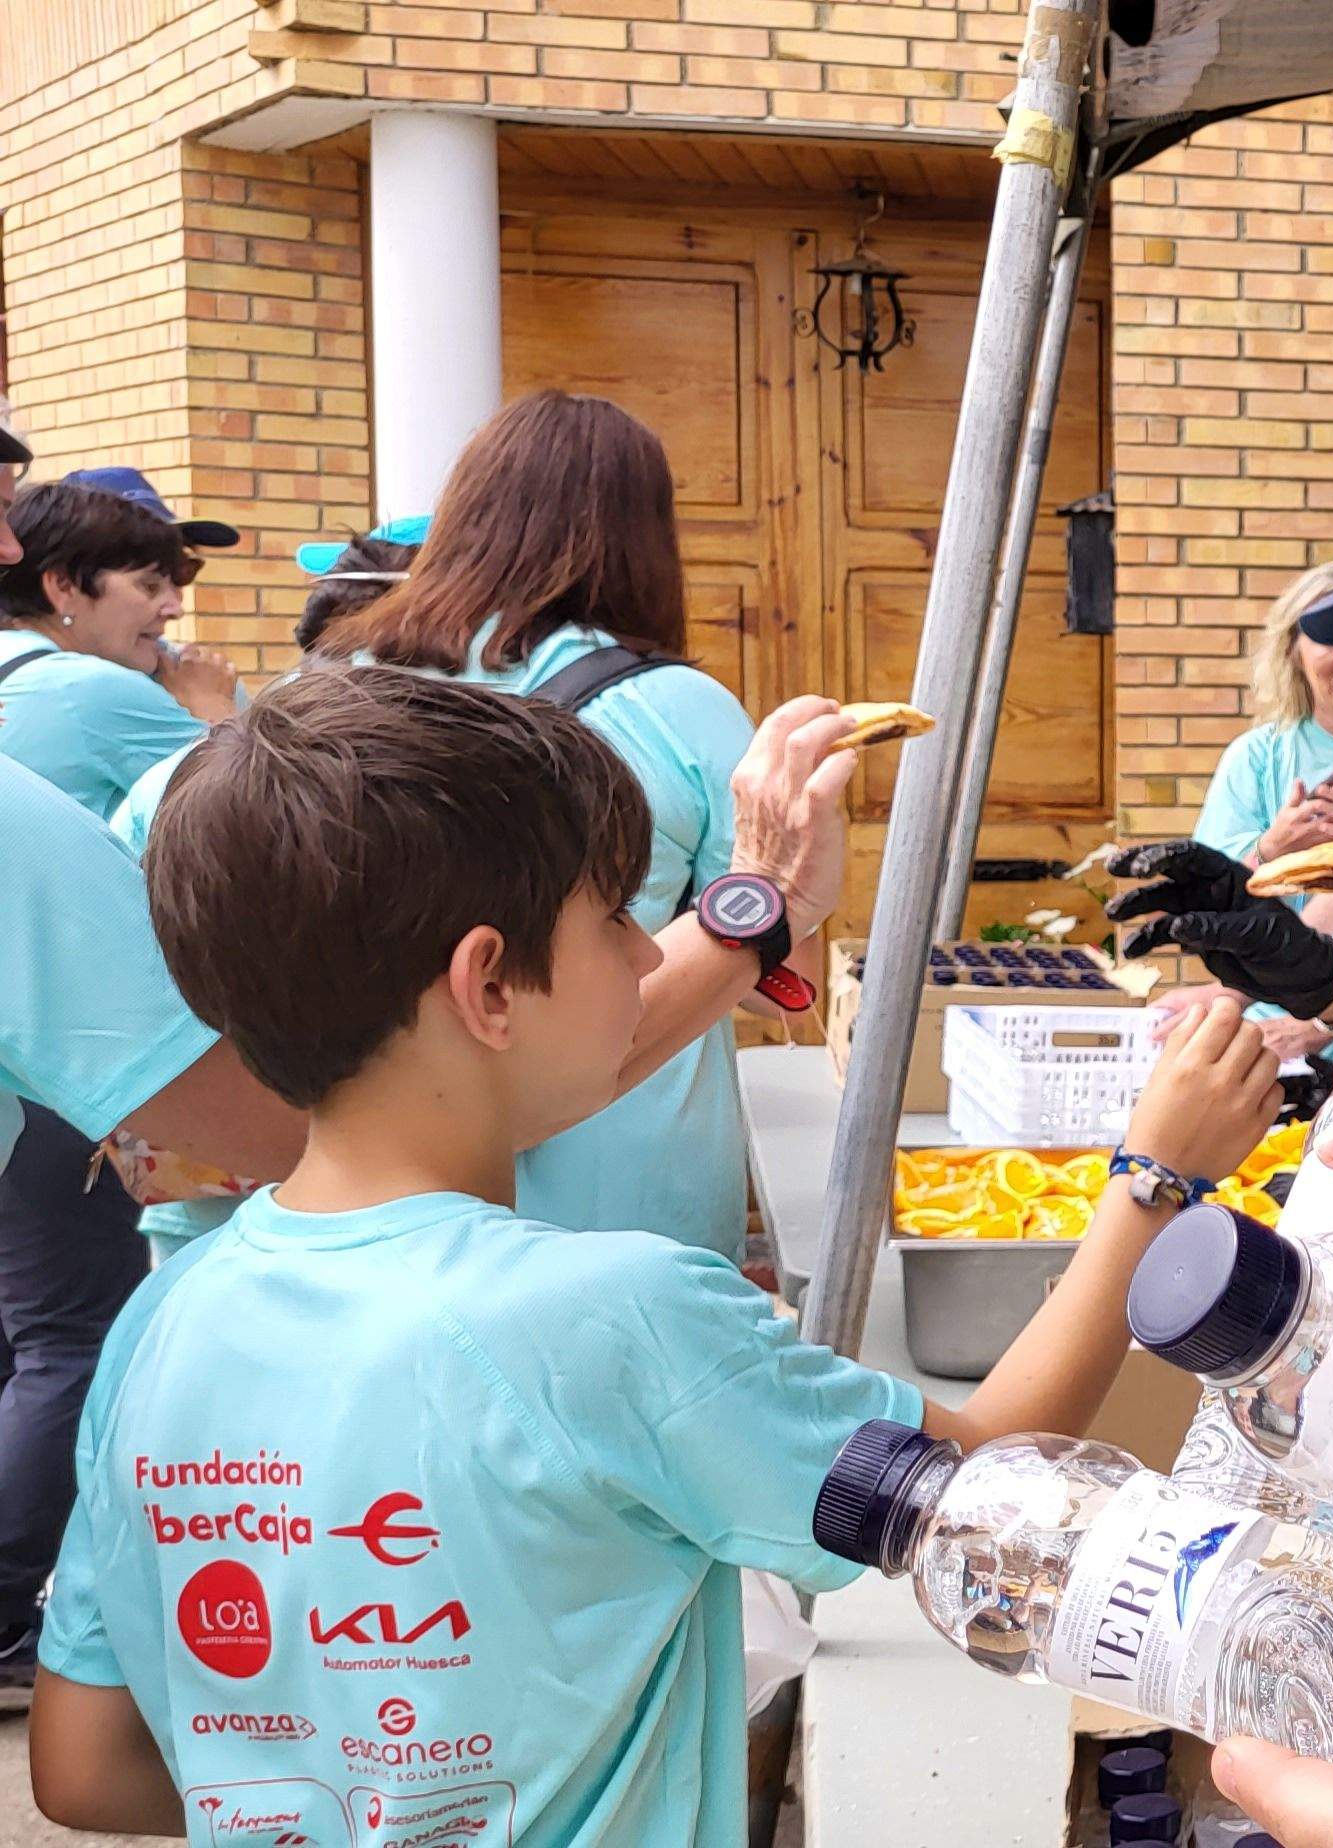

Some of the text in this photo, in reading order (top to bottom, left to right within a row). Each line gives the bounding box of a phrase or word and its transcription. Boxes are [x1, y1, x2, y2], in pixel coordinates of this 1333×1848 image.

[135, 1448, 303, 1489] Fundación
[309, 1600, 471, 1644] KIA
[405, 1654, 471, 1670] Huesca
[192, 1714, 297, 1734] avanza
[341, 1734, 492, 1766] escanero
[397, 1760, 494, 1782] SOLUTIONS
